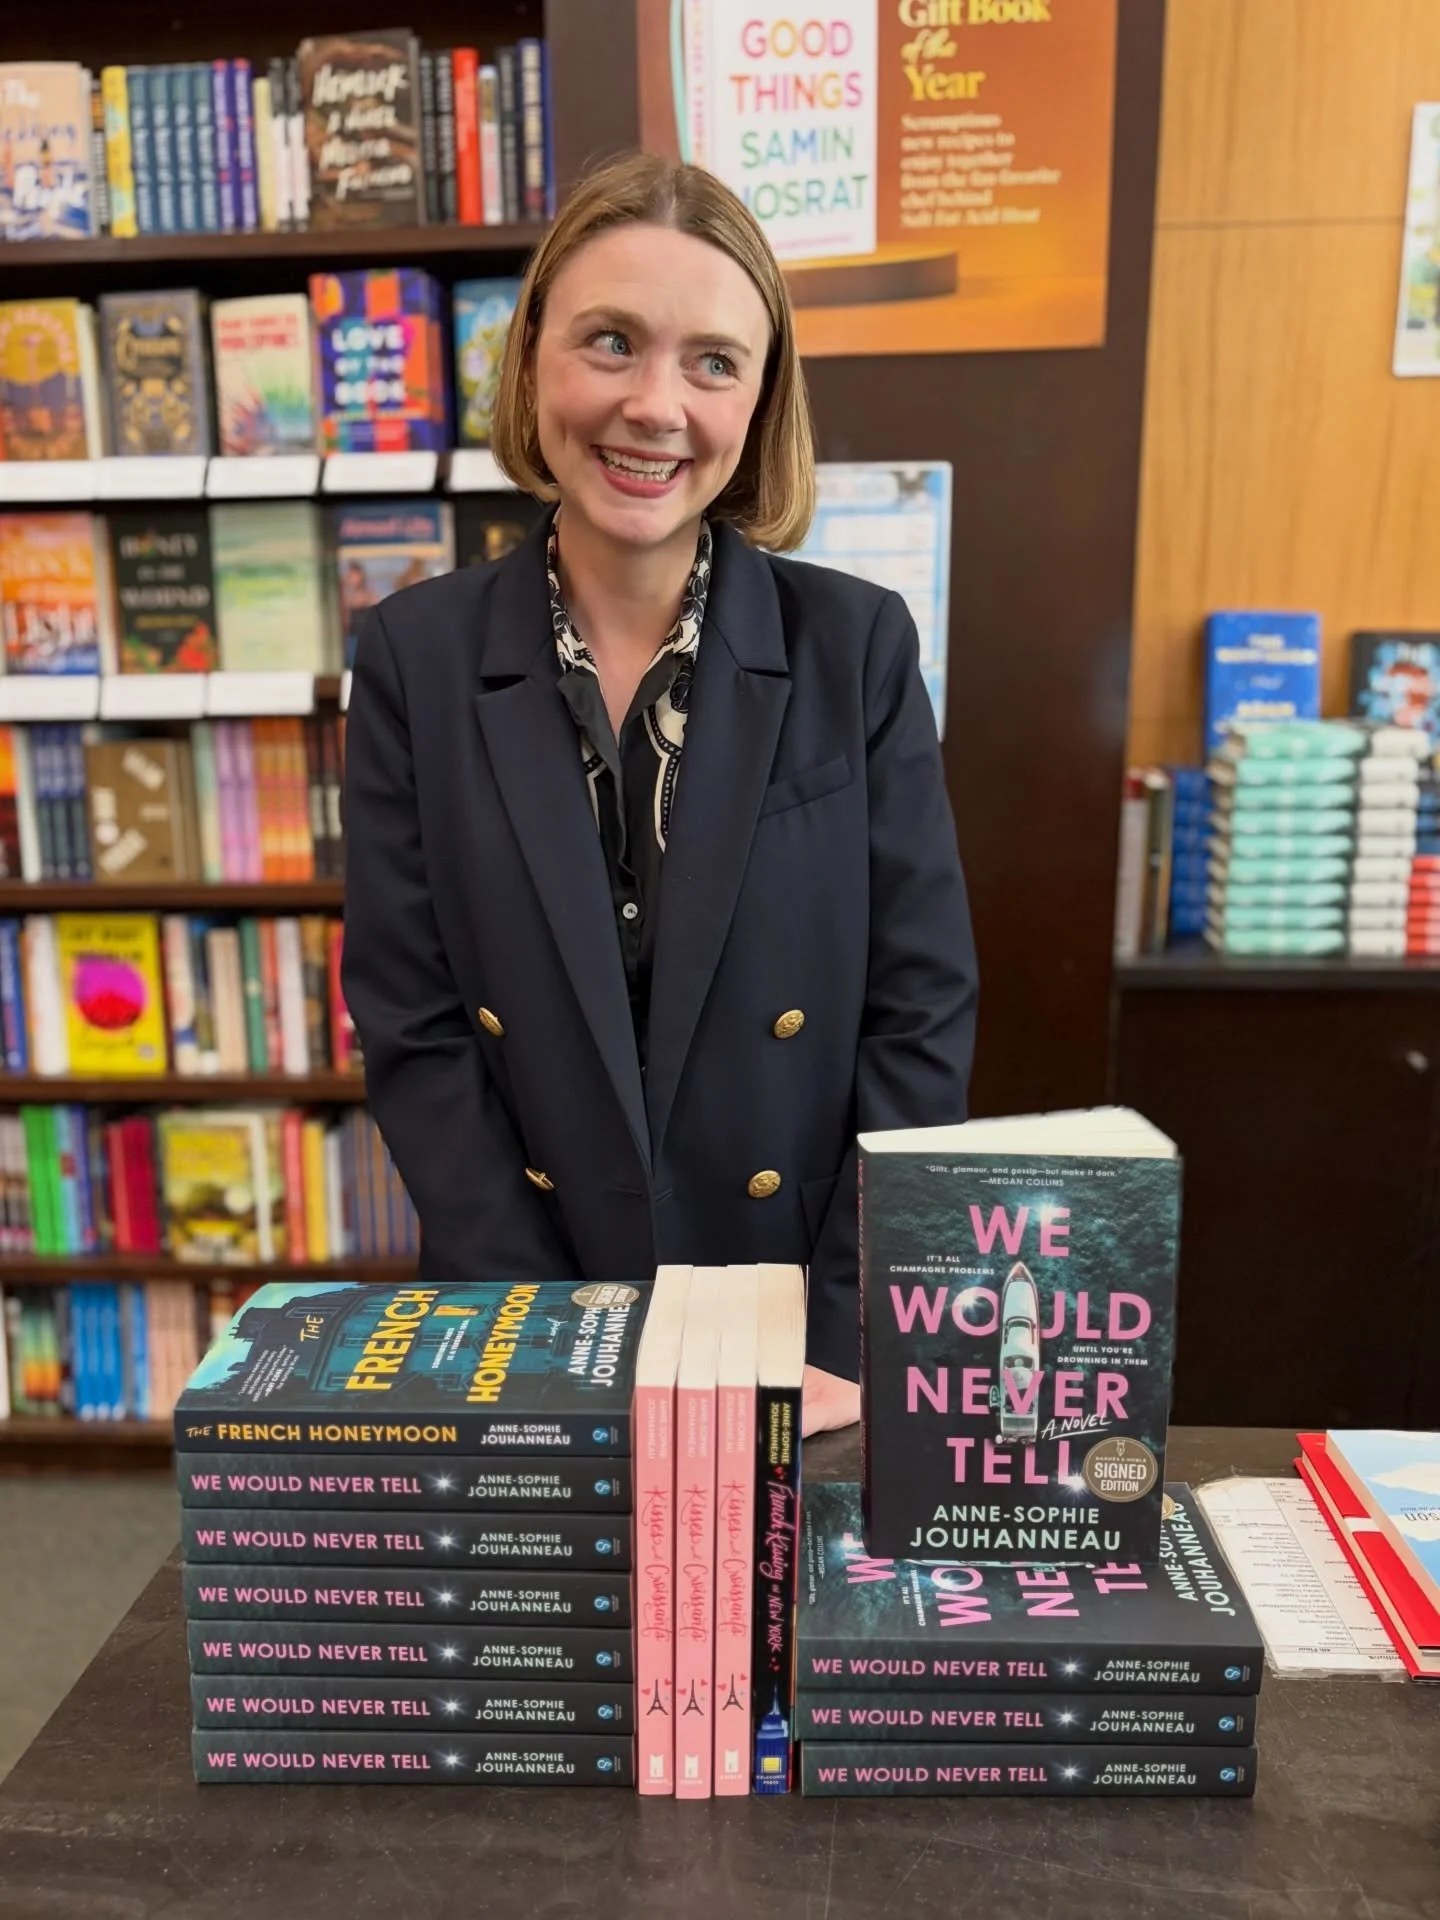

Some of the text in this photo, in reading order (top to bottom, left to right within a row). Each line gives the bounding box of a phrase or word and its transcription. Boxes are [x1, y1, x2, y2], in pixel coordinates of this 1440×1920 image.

[968, 0, 1052, 24] Book
[742, 20, 852, 59] GOOD
[904, 64, 987, 100] Year
[729, 72, 862, 114] THINGS
[742, 128, 854, 168] SAMIN
[332, 326, 403, 352] LOVE
[335, 381, 405, 405] BOOK
[969, 1205, 1070, 1257] WE
[890, 1266, 994, 1275] CHAMPAGNE PROBLEMS
[889, 1286, 1151, 1339] WOULD
[300, 1314, 324, 1343] THE
[345, 1290, 439, 1390] FRENCH
[466, 1284, 541, 1402] HONEYMOON
[568, 1307, 602, 1375] ANNE-SOPH
[591, 1303, 631, 1386] JOUHANNE
[907, 1367, 1129, 1419] NEVER
[185, 1425, 457, 1442] THE FRENCH HONEYMOON
[489, 1424, 561, 1434] ANNE-SOPHIE
[769, 1401, 779, 1464] JOUHANNEAU
[782, 1402, 791, 1464] ANNE-SOPHIE
[1042, 1409, 1112, 1439] A NOVEL
[480, 1434, 571, 1445] JOUHANNEAU
[947, 1437, 1084, 1484] TELL
[478, 1475, 560, 1485] ANNE-SOPHIE
[1094, 1463, 1146, 1480] SIGNED
[191, 1475, 422, 1493] WE WOULD NEVER TELL
[467, 1486, 571, 1498] JOUHANNEAU
[1101, 1480, 1138, 1492] EDITION
[640, 1485, 669, 1546] Kisses
[680, 1484, 708, 1545] Kisses
[719, 1479, 746, 1540] Kisses
[933, 1505, 1099, 1524] ANNE-SOPHIE
[196, 1531, 424, 1550] WE WOULD NEVER TELL
[480, 1533, 561, 1543] ANNE-SOPHIE
[910, 1528, 1120, 1550] JOUHANNEAU
[469, 1544, 573, 1556] JOUHANNEAU
[759, 1481, 794, 1653] French Kissing NEW YORK
[199, 1587, 424, 1606] WE WOULD NEVER TELL
[480, 1589, 560, 1600] ANNE-SOPHIE
[641, 1563, 671, 1643] Croissants
[680, 1562, 708, 1642] Croissants
[718, 1558, 748, 1637] Croissants
[469, 1600, 571, 1613] JOUHANNEAU
[203, 1642, 428, 1661] WE WOULD NEVER TELL
[483, 1645, 563, 1656] ANNE-SOPHIE
[472, 1656, 574, 1668] JOUHANNEAU
[812, 1658, 1047, 1677] WE WOULD NEVER TELL
[1106, 1660, 1191, 1671] ANNE-SOPHIE
[1094, 1670, 1200, 1683] JOUHANNEAU
[207, 1697, 430, 1716] WE WOULD NEVER TELL
[485, 1699, 564, 1709] ANNE-SOPHIE
[475, 1710, 575, 1721] JOUHANNEAU
[812, 1709, 1043, 1727] WE WOULD NEVER TELL
[1101, 1710, 1185, 1721] ANNE-SOPHIE
[1089, 1721, 1194, 1734] JOUHANNEAU
[208, 1753, 431, 1769] WE WOULD NEVER TELL
[485, 1752, 564, 1762] ANNE-SOPHIE
[475, 1763, 575, 1774] JOUHANNEAU
[818, 1766, 1047, 1782] WE WOULD NEVER TELL
[1105, 1764, 1187, 1773] ANNE-SOPHIE
[1093, 1773, 1196, 1785] JOUHANNEAU
